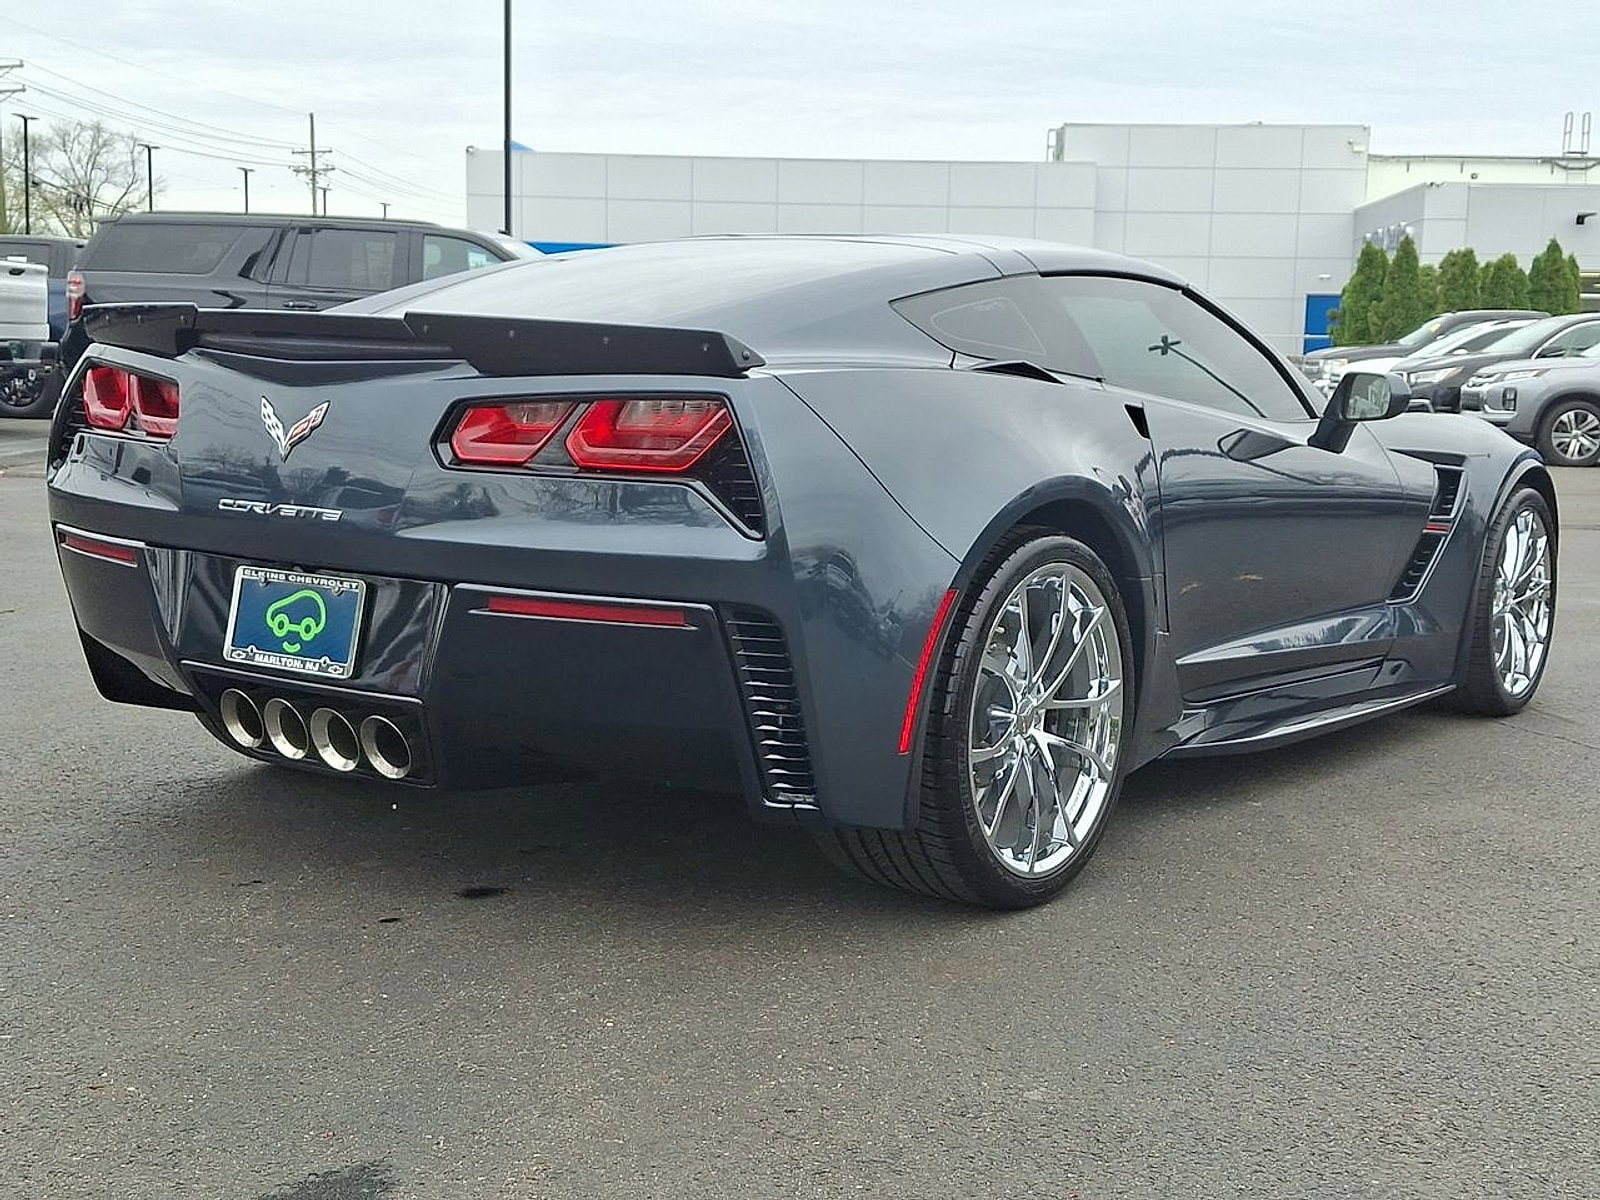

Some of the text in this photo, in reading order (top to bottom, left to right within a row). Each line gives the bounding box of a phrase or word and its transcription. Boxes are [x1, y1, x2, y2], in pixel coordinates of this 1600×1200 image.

[218, 498, 342, 521] CORVETTE
[244, 569, 358, 589] ELKINS CHEVROLET
[305, 661, 320, 671] NJ
